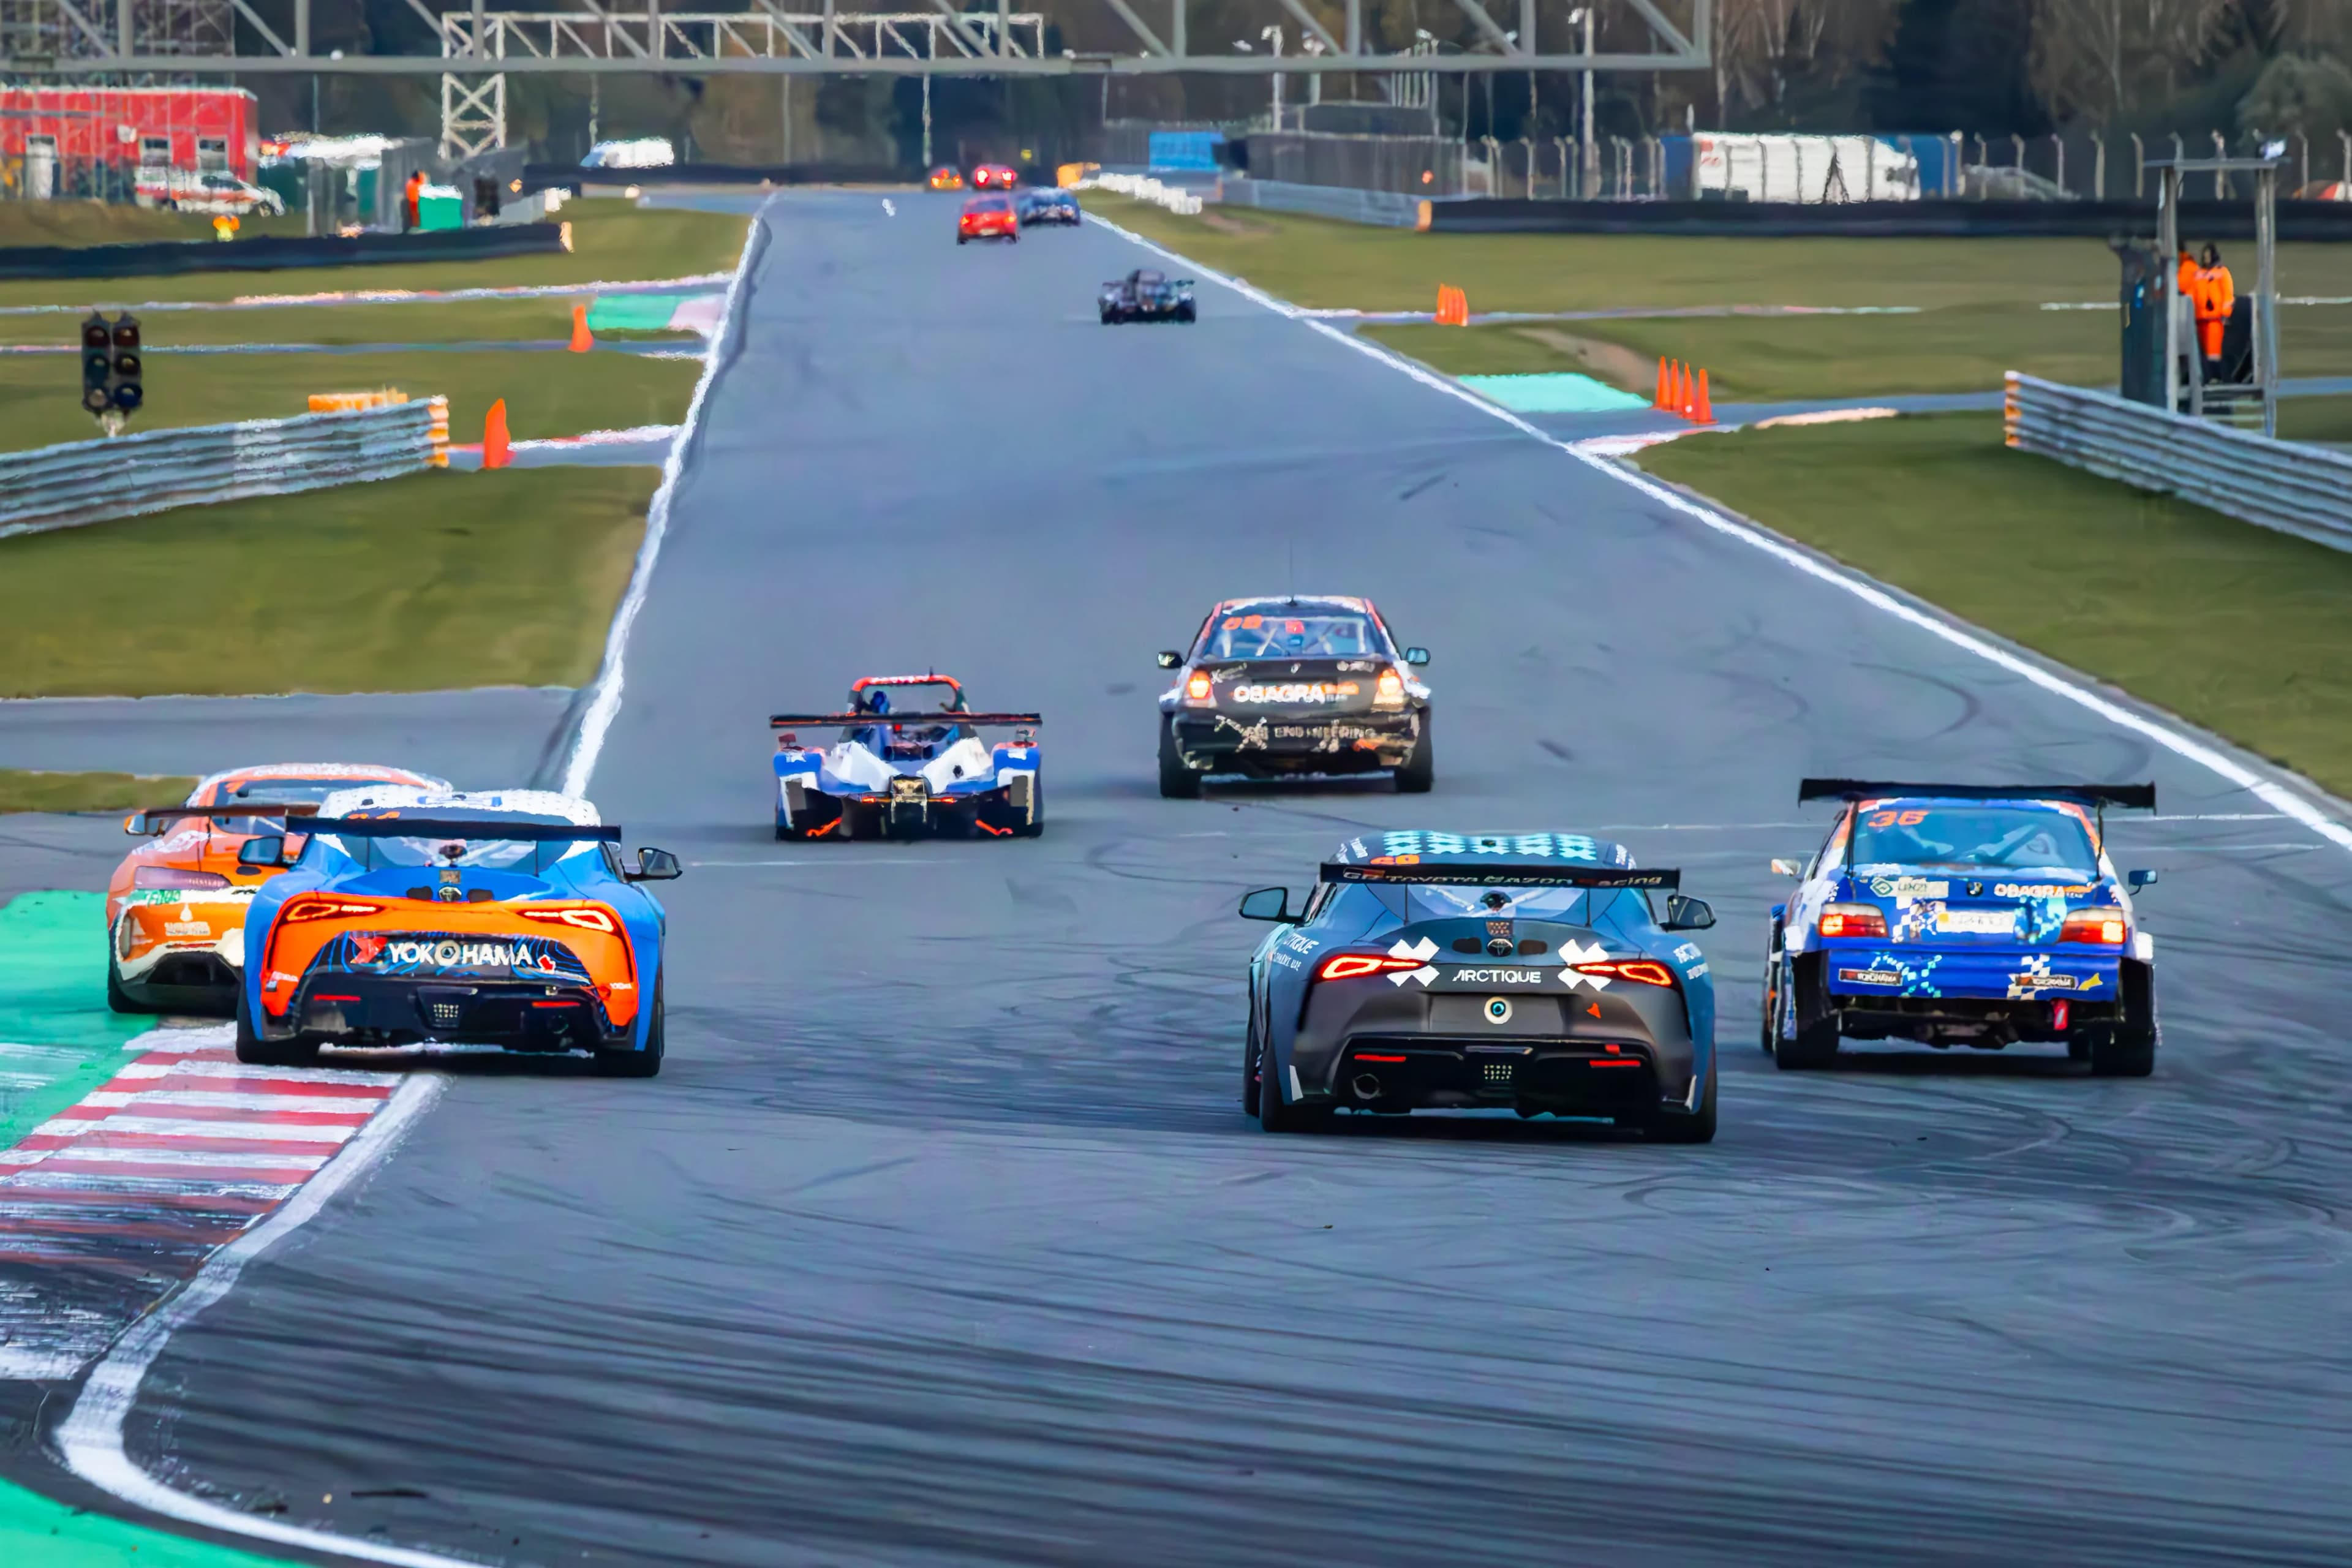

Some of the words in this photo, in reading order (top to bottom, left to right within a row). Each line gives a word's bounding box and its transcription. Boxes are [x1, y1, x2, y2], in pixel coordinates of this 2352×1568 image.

[1868, 810, 1929, 827] 36
[1994, 883, 2065, 899] OBAGRA
[388, 940, 533, 967] YOKOHAMA
[1452, 969, 1542, 984] ARCTIQUE
